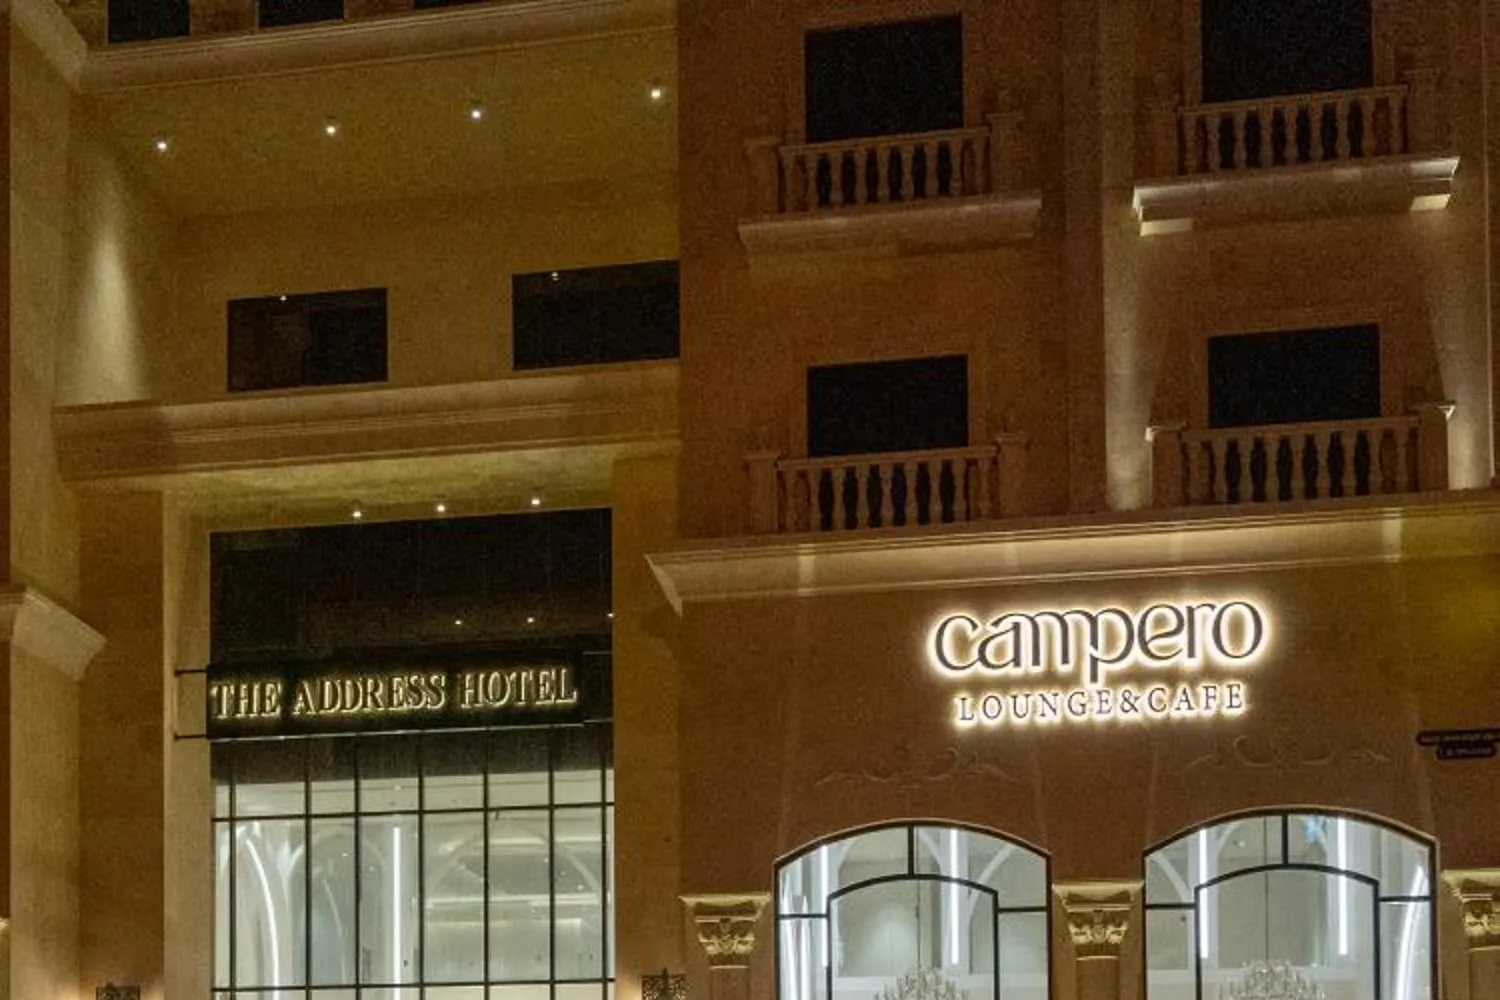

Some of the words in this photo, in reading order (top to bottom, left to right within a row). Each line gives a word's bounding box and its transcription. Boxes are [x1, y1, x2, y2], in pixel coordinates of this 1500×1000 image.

[934, 601, 1264, 684] campero
[209, 678, 282, 719] THE
[292, 673, 447, 715] ADDRESS
[460, 668, 579, 708] HOTEL
[959, 684, 1244, 721] LOUNGE&CAFE
